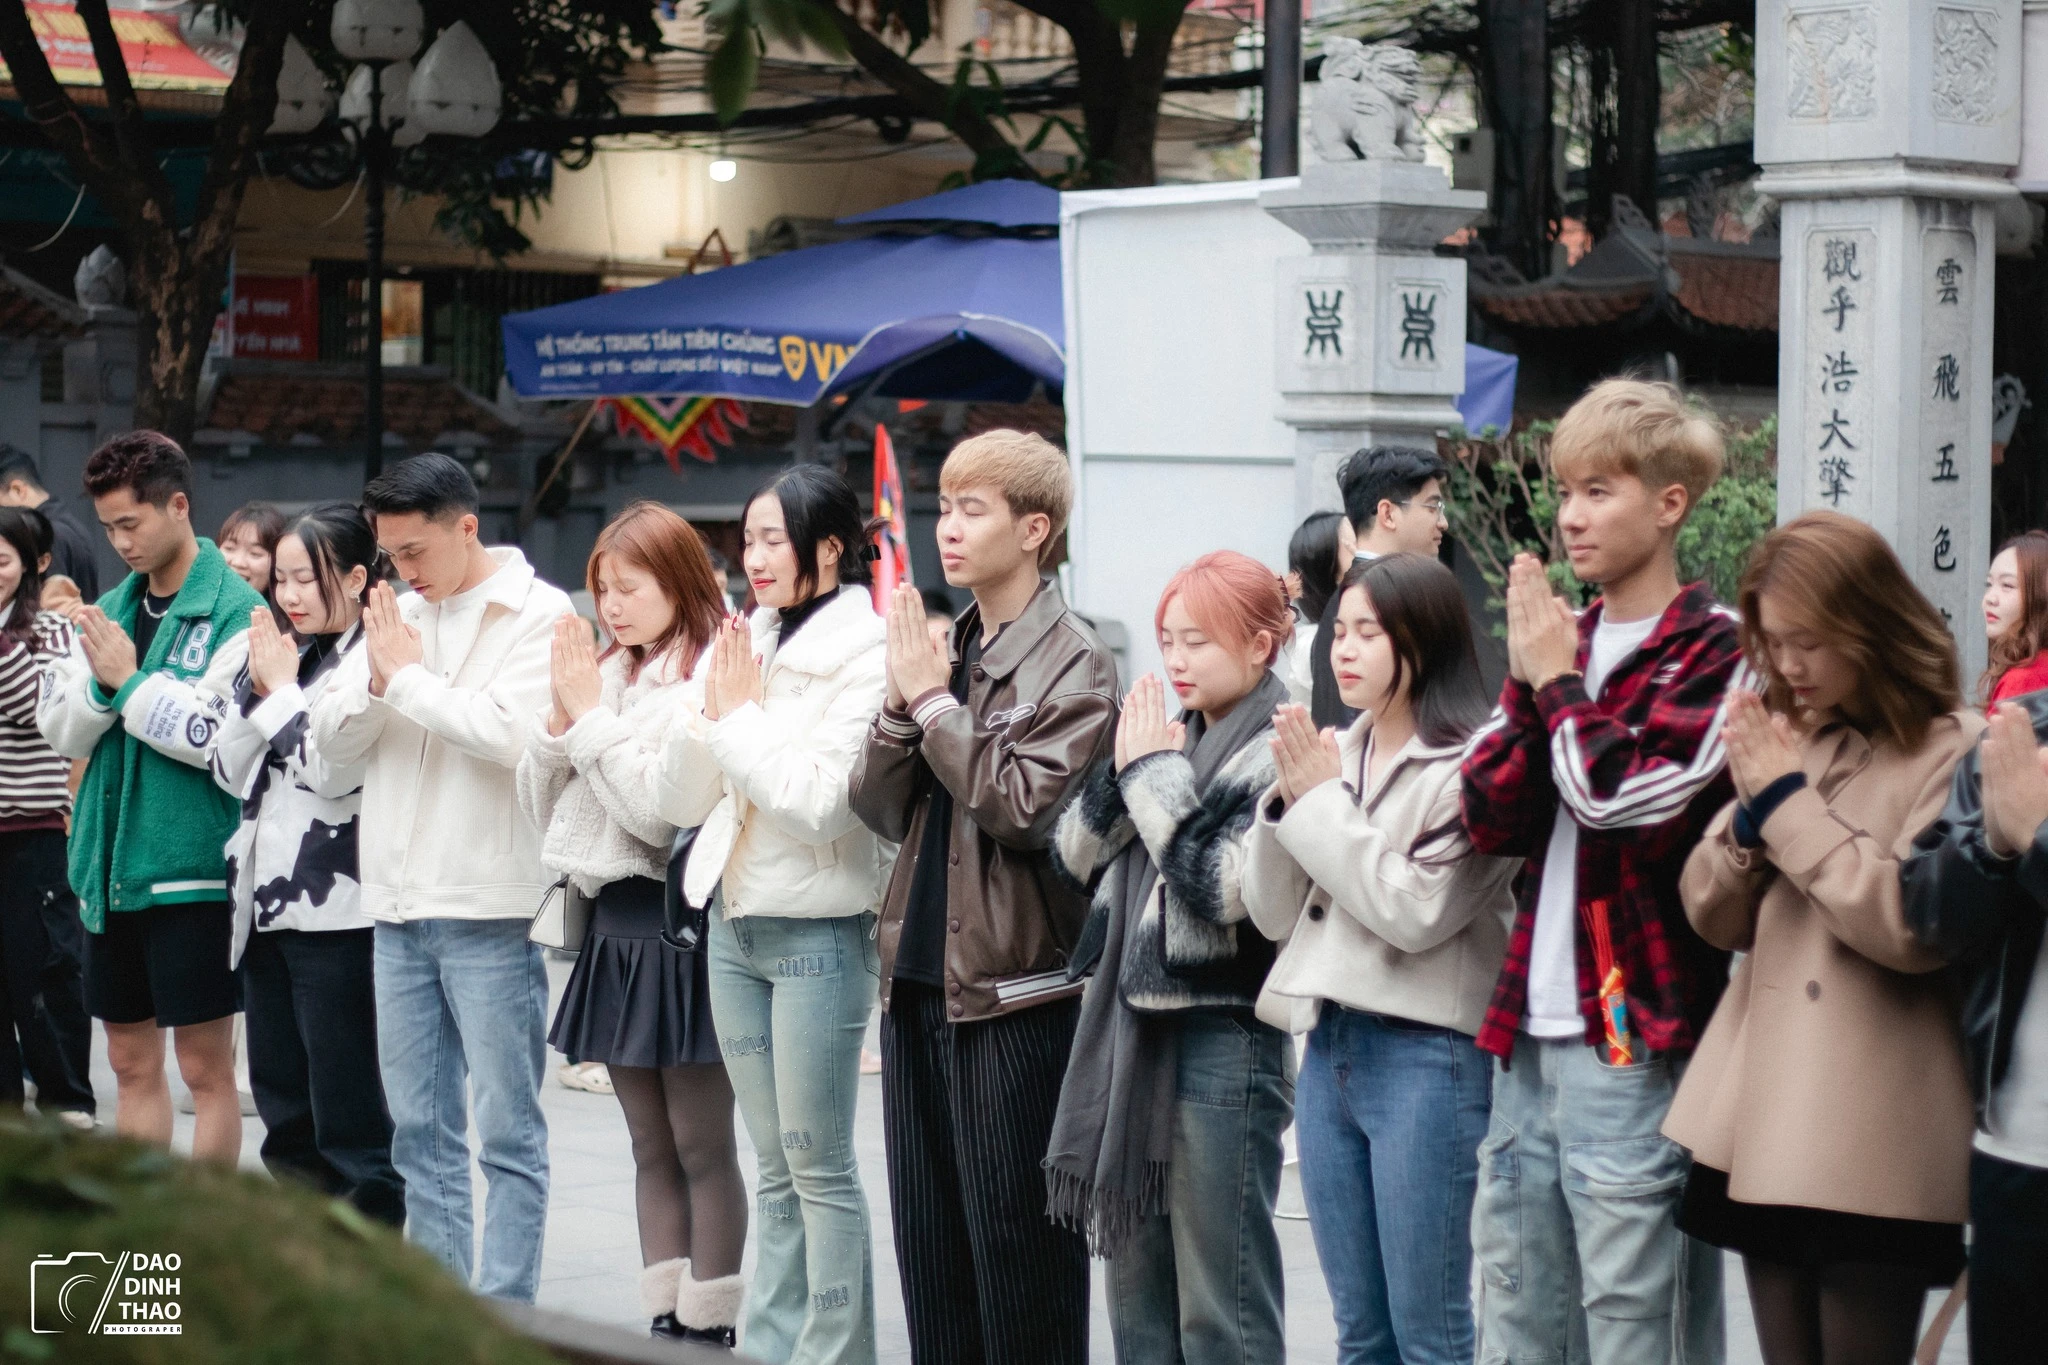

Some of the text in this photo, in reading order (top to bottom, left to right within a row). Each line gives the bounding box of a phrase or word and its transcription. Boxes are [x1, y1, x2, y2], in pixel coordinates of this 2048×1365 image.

[603, 333, 651, 353] TRUNG
[1932, 258, 1962, 618] 雲飛五色
[165, 619, 213, 671] 18
[153, 717, 168, 739] thing
